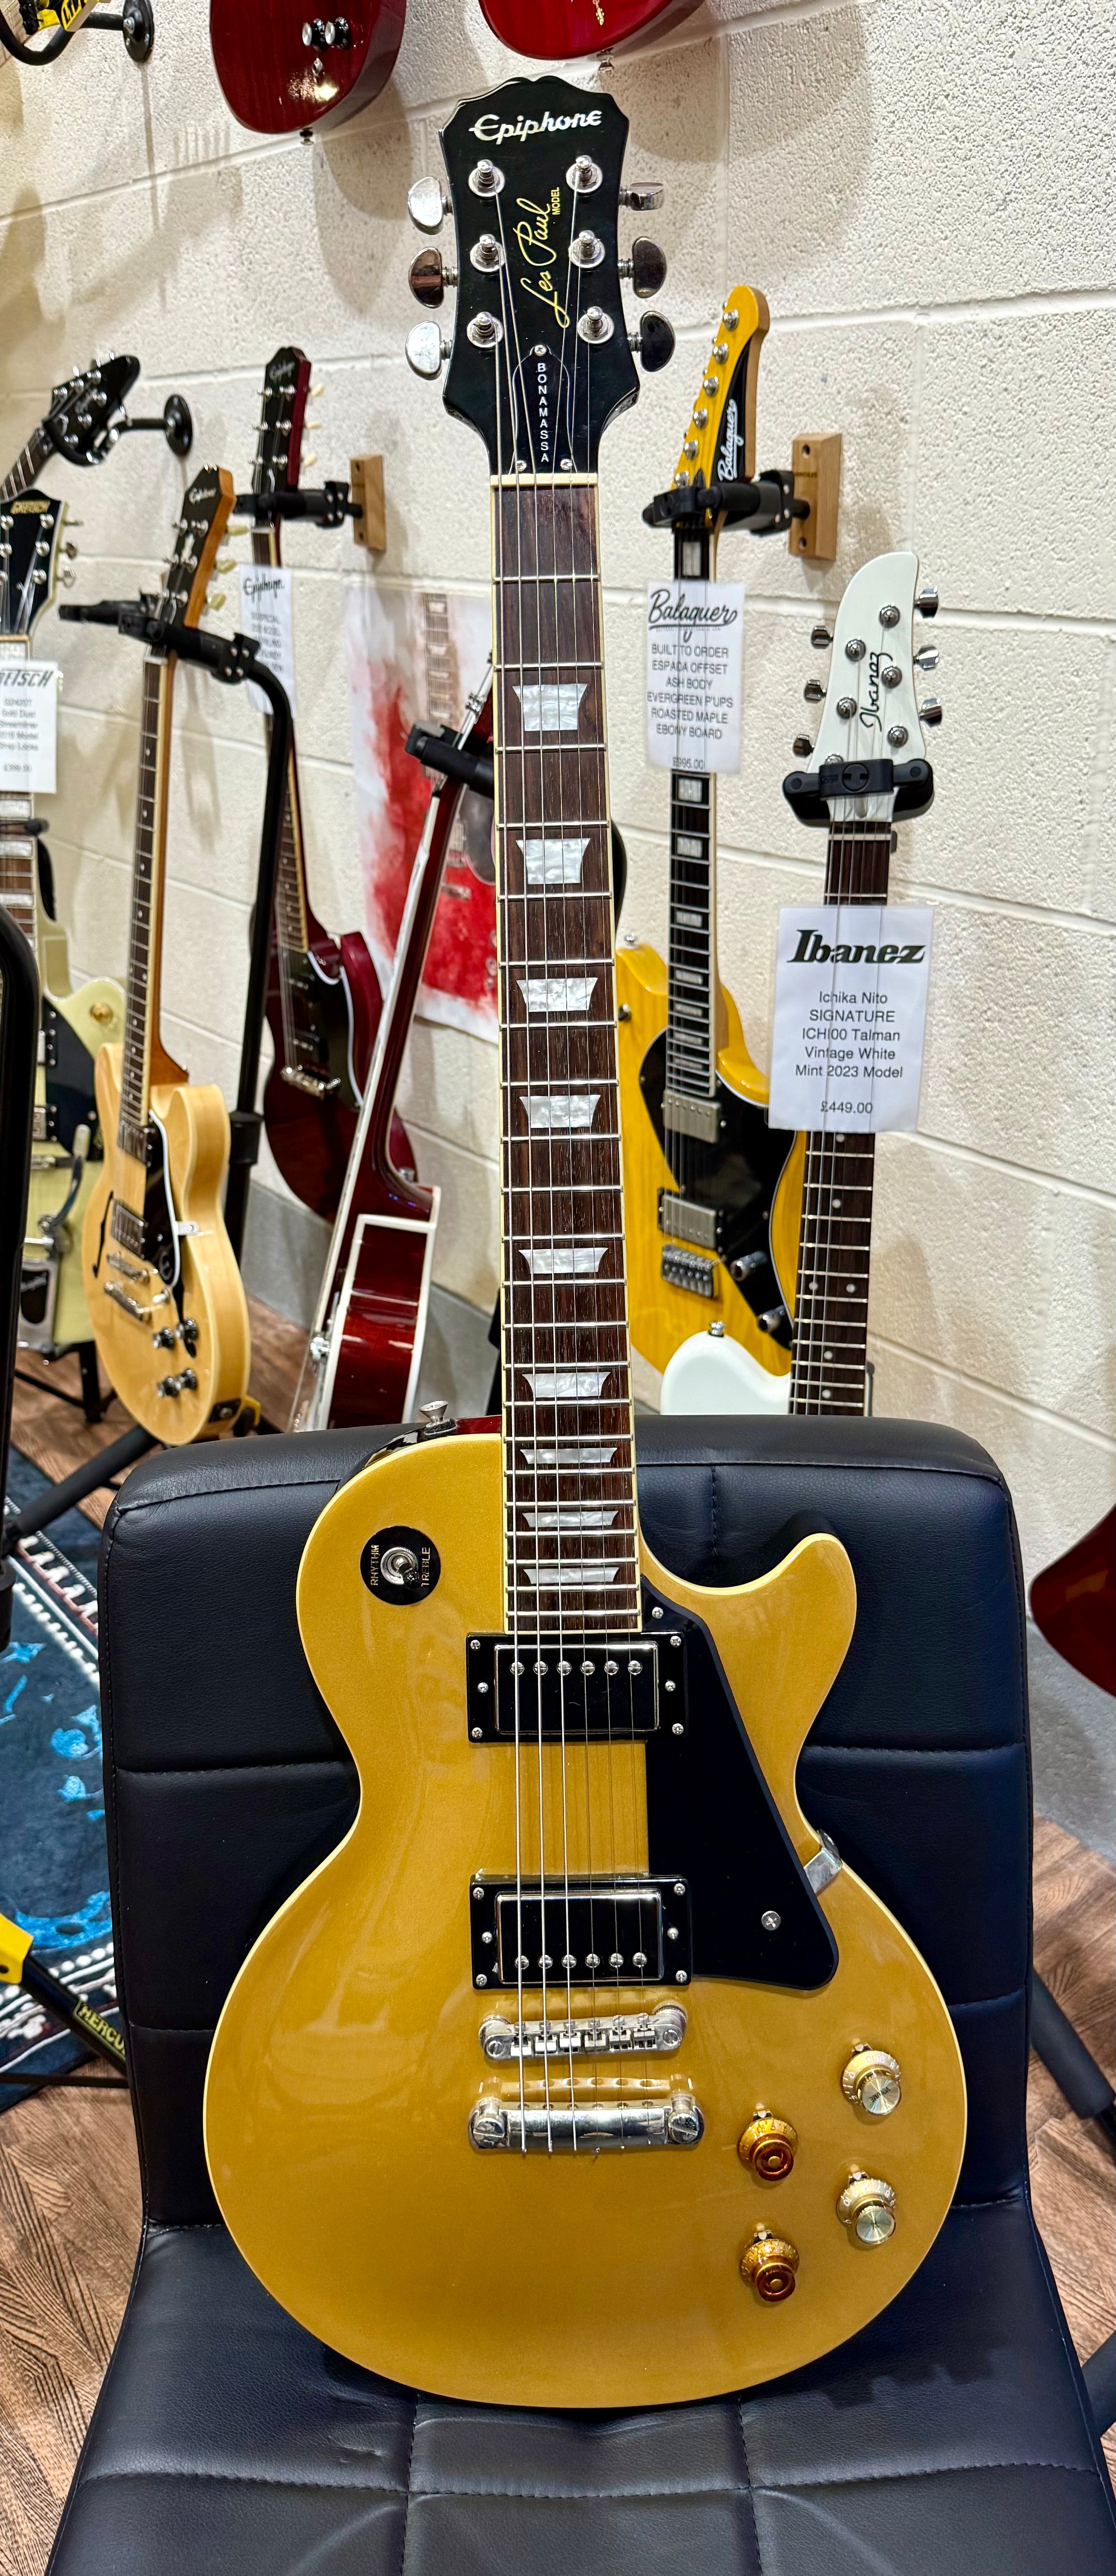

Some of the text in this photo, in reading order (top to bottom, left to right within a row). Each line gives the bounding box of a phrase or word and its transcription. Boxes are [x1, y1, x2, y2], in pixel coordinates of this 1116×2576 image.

[468, 110, 602, 145] Epiphone
[551, 187, 561, 215] MODEL
[512, 198, 570, 328] Les Paul
[537, 363, 549, 462] BONAMASSA
[717, 399, 744, 482] Balaguer
[648, 589, 738, 643] Balaguer
[652, 644, 729, 658] BUILT TO ORDER
[652, 660, 728, 675] ESPADA OFFSET
[666, 677, 713, 690] ASH BODY
[859, 651, 893, 732] Ibanez
[647, 691, 734, 708] EVERGREEN P'UPS
[651, 707, 729, 724] ROASTED MAPLE
[656, 723, 723, 740] EBONY BOARD
[786, 929, 926, 964] Ibanez
[820, 991, 888, 1004] Ichika Nito
[809, 1009, 896, 1022] SIGNATURE
[851, 1029, 900, 1041] Talman
[805, 1046, 896, 1062] Vintage White
[795, 1064, 903, 1078] Mint 2023 Model
[820, 1100, 873, 1114] £449.00
[370, 1544, 380, 1586] RHYTHM
[421, 1547, 430, 1587] TREBLE
